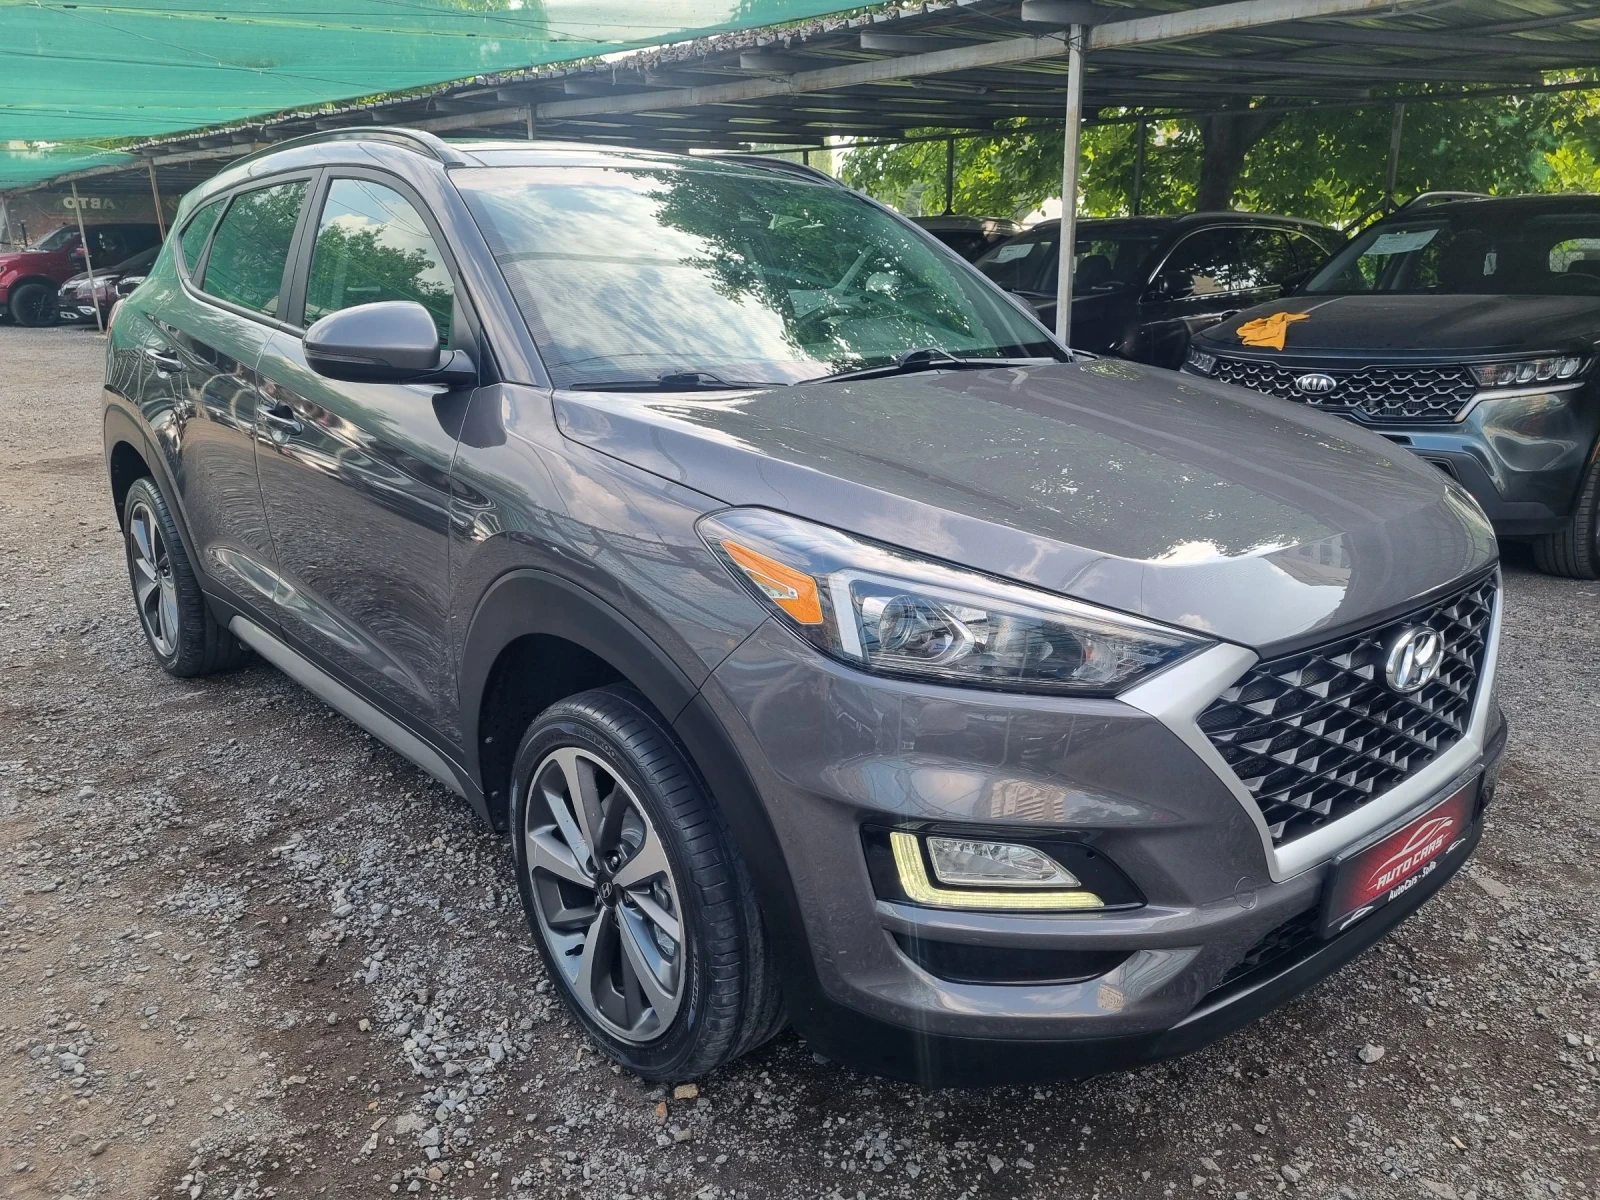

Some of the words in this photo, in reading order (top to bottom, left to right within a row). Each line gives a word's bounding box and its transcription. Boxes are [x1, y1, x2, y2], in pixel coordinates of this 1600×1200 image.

[1302, 377, 1328, 390] KIA
[1376, 857, 1412, 890] AUTO
[1412, 834, 1444, 866] CARS
